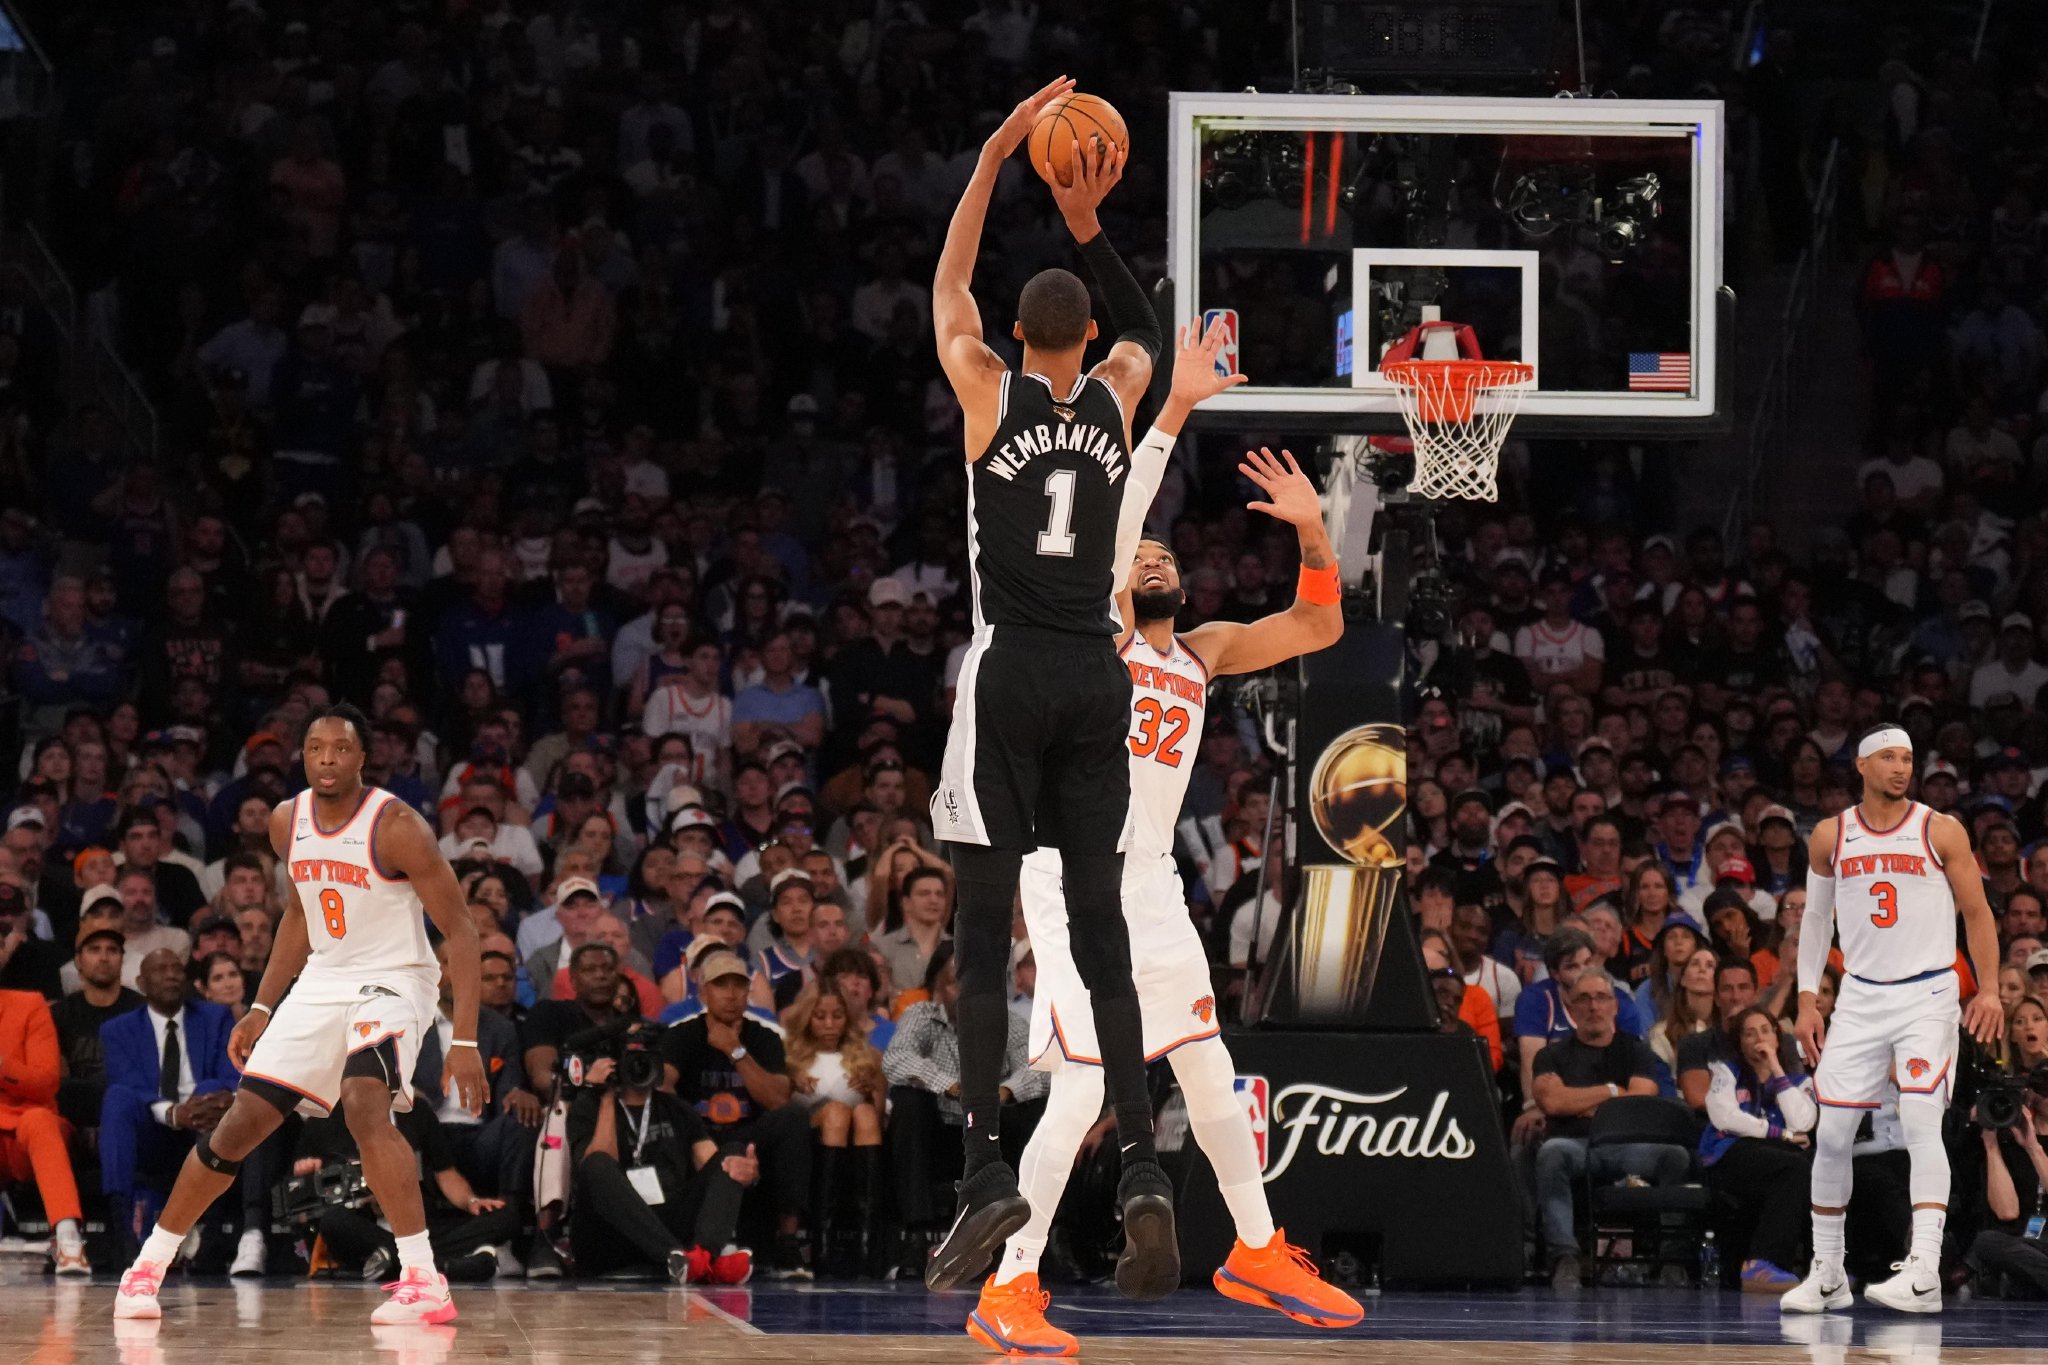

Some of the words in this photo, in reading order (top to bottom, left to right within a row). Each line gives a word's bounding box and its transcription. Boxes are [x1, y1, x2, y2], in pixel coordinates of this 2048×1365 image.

[986, 423, 1124, 487] WEMBANYAMA
[1036, 469, 1077, 557] 1
[1128, 661, 1166, 692] NEW
[1164, 672, 1204, 710] YORK
[1129, 697, 1190, 768] 32
[291, 859, 322, 883] NEW
[323, 859, 371, 890] YORK
[1840, 854, 1878, 880] NEW
[1880, 854, 1927, 877] YORK
[319, 888, 347, 940] 8
[1869, 881, 1898, 928] 3
[1262, 1083, 1476, 1183] Finals
